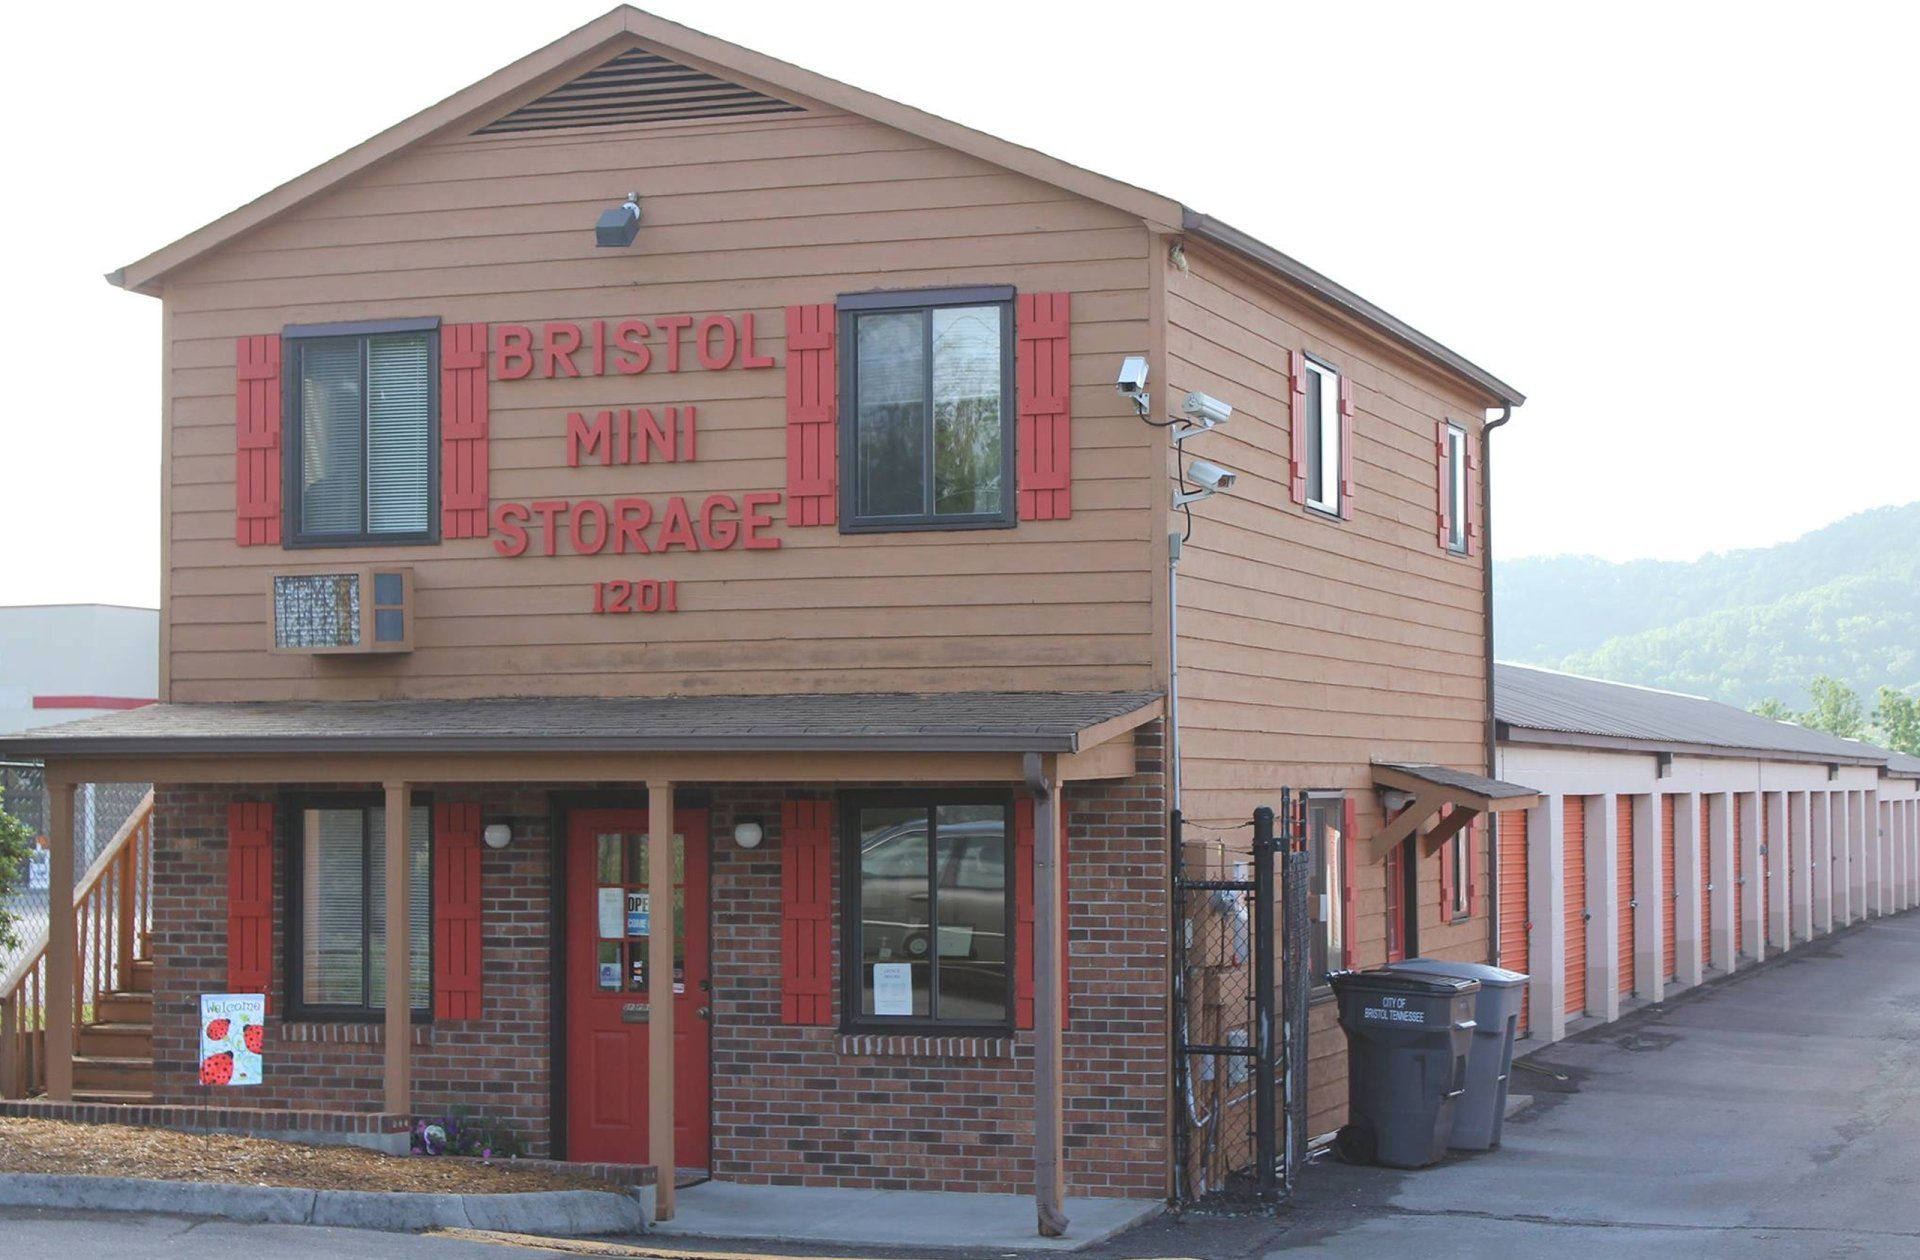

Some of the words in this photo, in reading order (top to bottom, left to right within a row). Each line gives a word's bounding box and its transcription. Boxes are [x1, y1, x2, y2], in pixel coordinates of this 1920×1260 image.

[496, 312, 775, 381] BRISTOL
[567, 406, 697, 468] MINI
[493, 493, 781, 557] STORAGE
[593, 580, 678, 614] 1201
[628, 896, 649, 912] OPE
[206, 999, 261, 1014] Welcome
[1364, 1007, 1389, 1020] BRISTOL
[1389, 1010, 1425, 1023] TENNESSEE
[1382, 996, 1396, 1008] CITY
[1396, 997, 1407, 1009] OF
